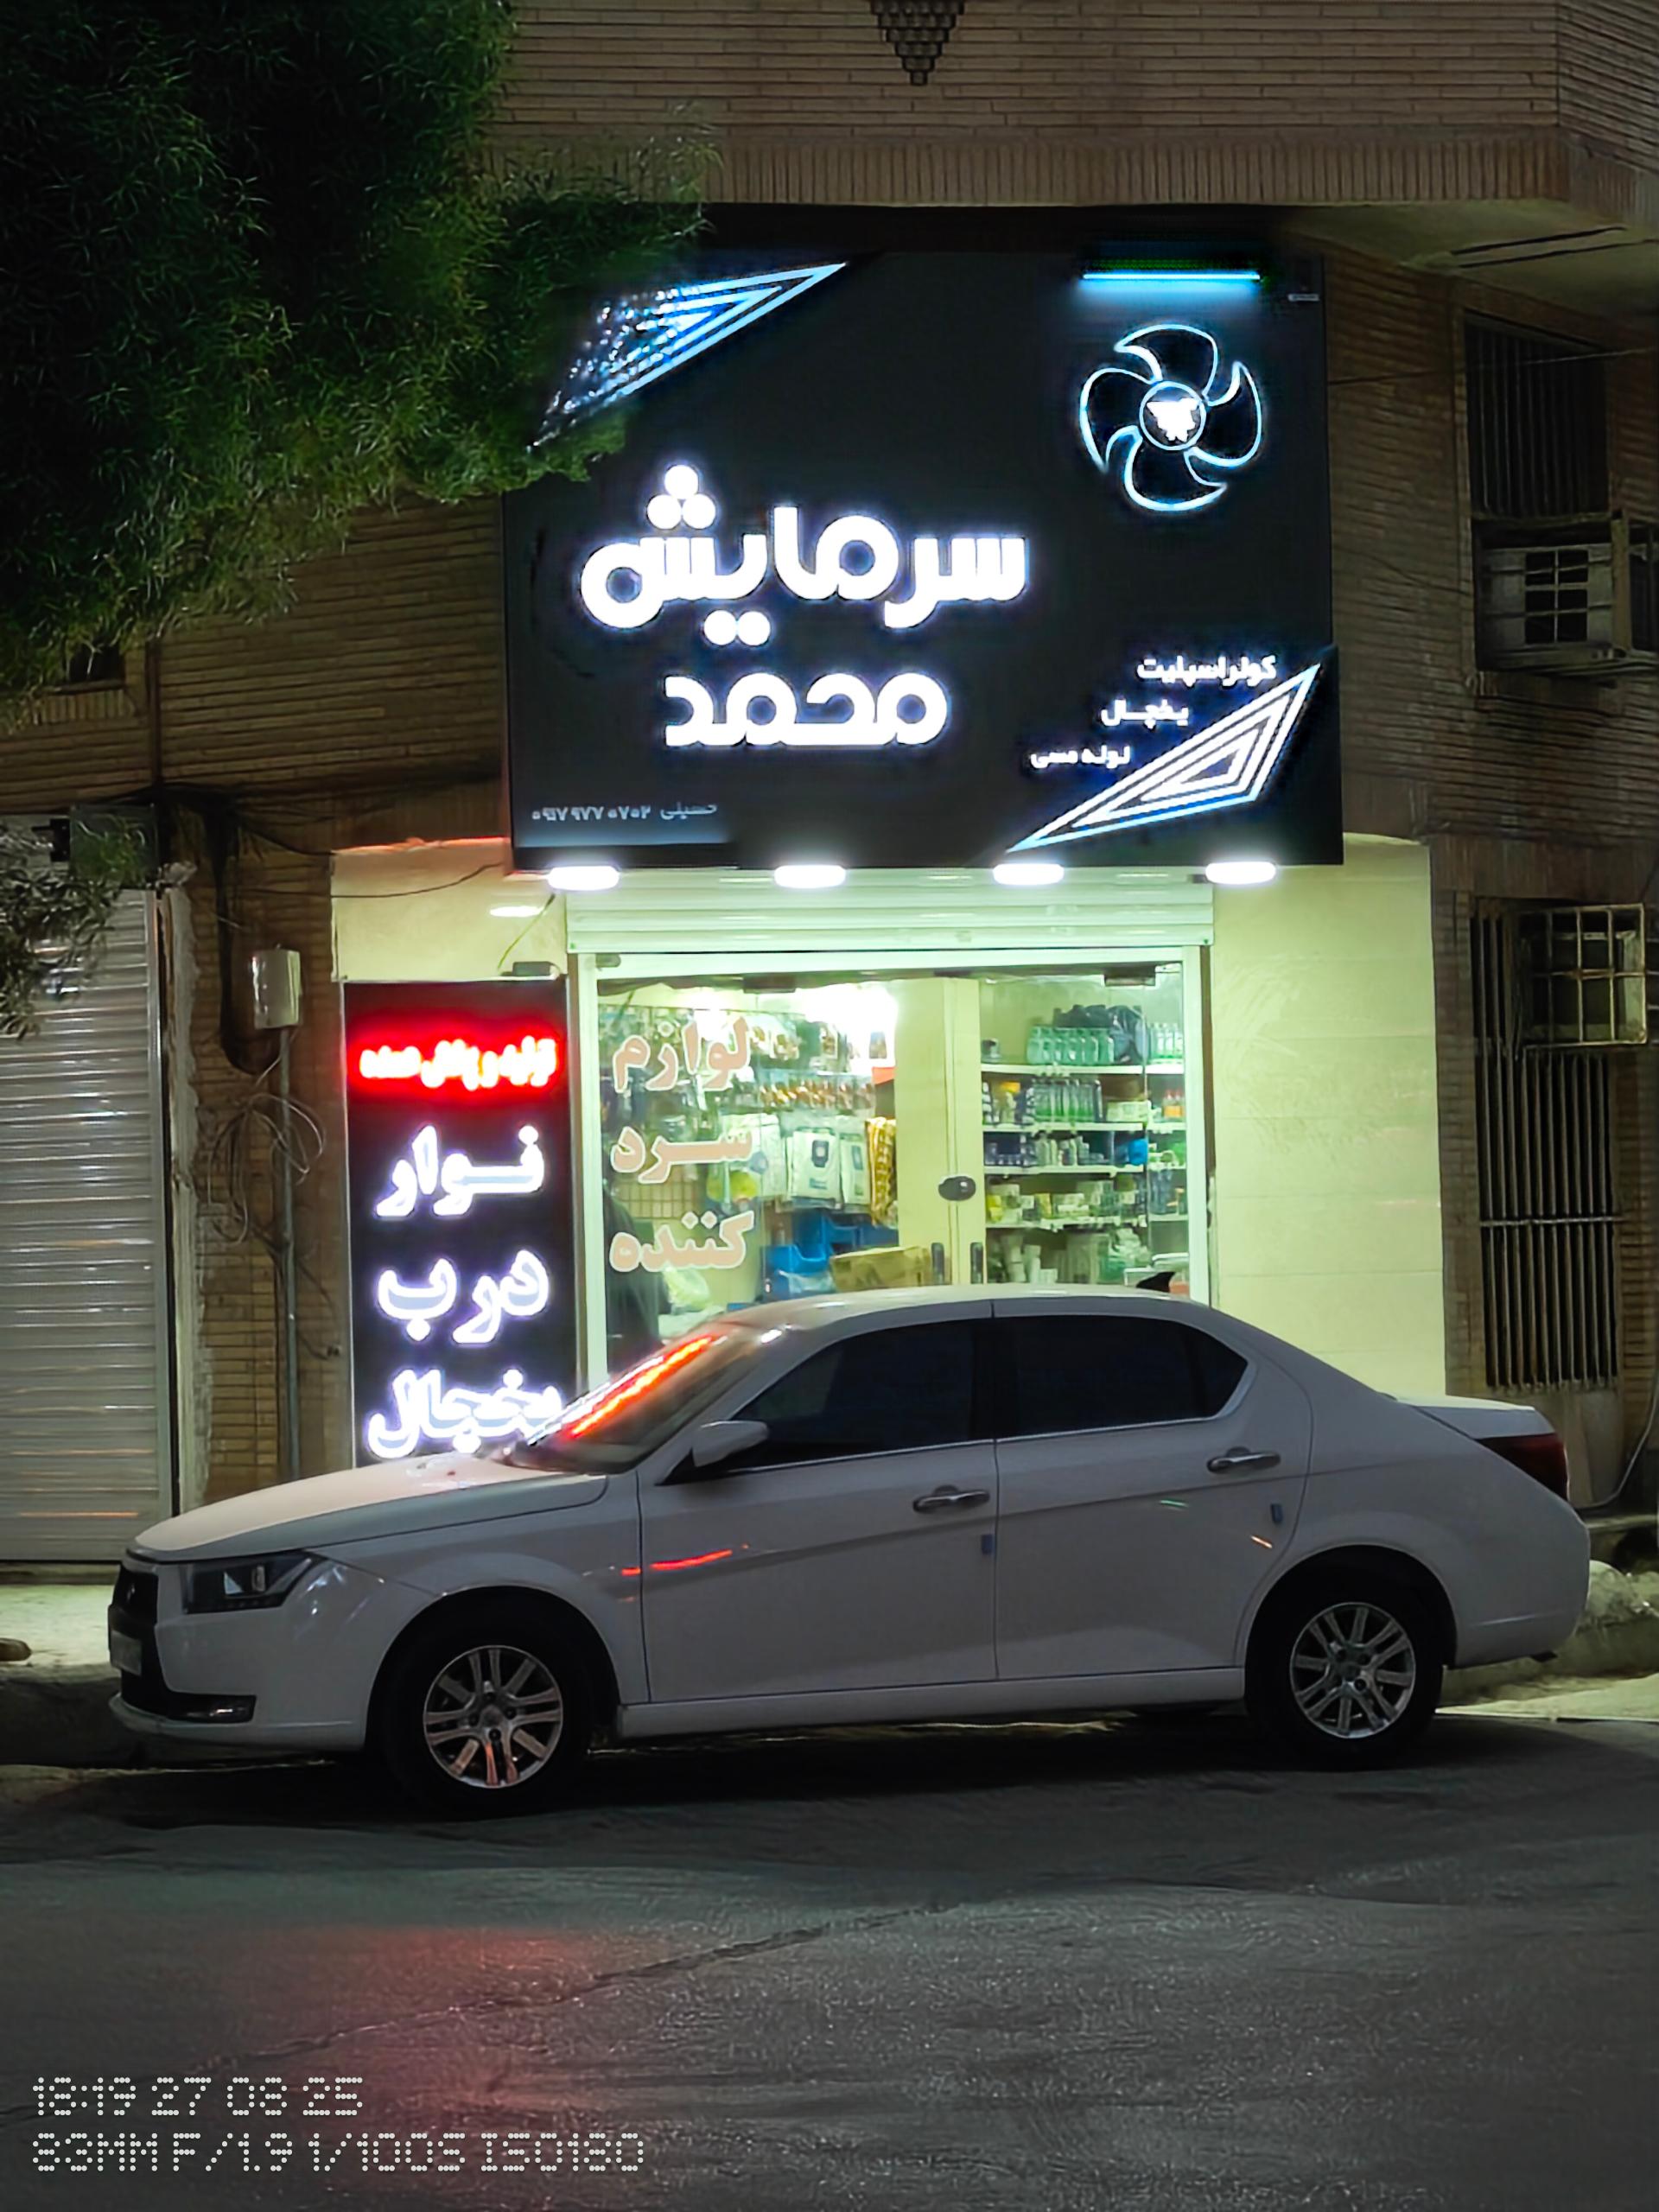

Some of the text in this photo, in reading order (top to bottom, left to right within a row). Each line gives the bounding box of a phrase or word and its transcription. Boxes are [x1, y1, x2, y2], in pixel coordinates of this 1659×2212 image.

[581, 464, 1026, 645] سرمایش
[665, 672, 947, 747] محمد
[1101, 699, 1189, 729] یخچال
[1081, 745, 1131, 769] لوله
[612, 1016, 752, 1093] لوازم
[376, 1125, 545, 1217] نوار
[610, 1127, 753, 1185] سرد
[609, 1210, 754, 1272] کننده
[378, 1249, 550, 1344] درب
